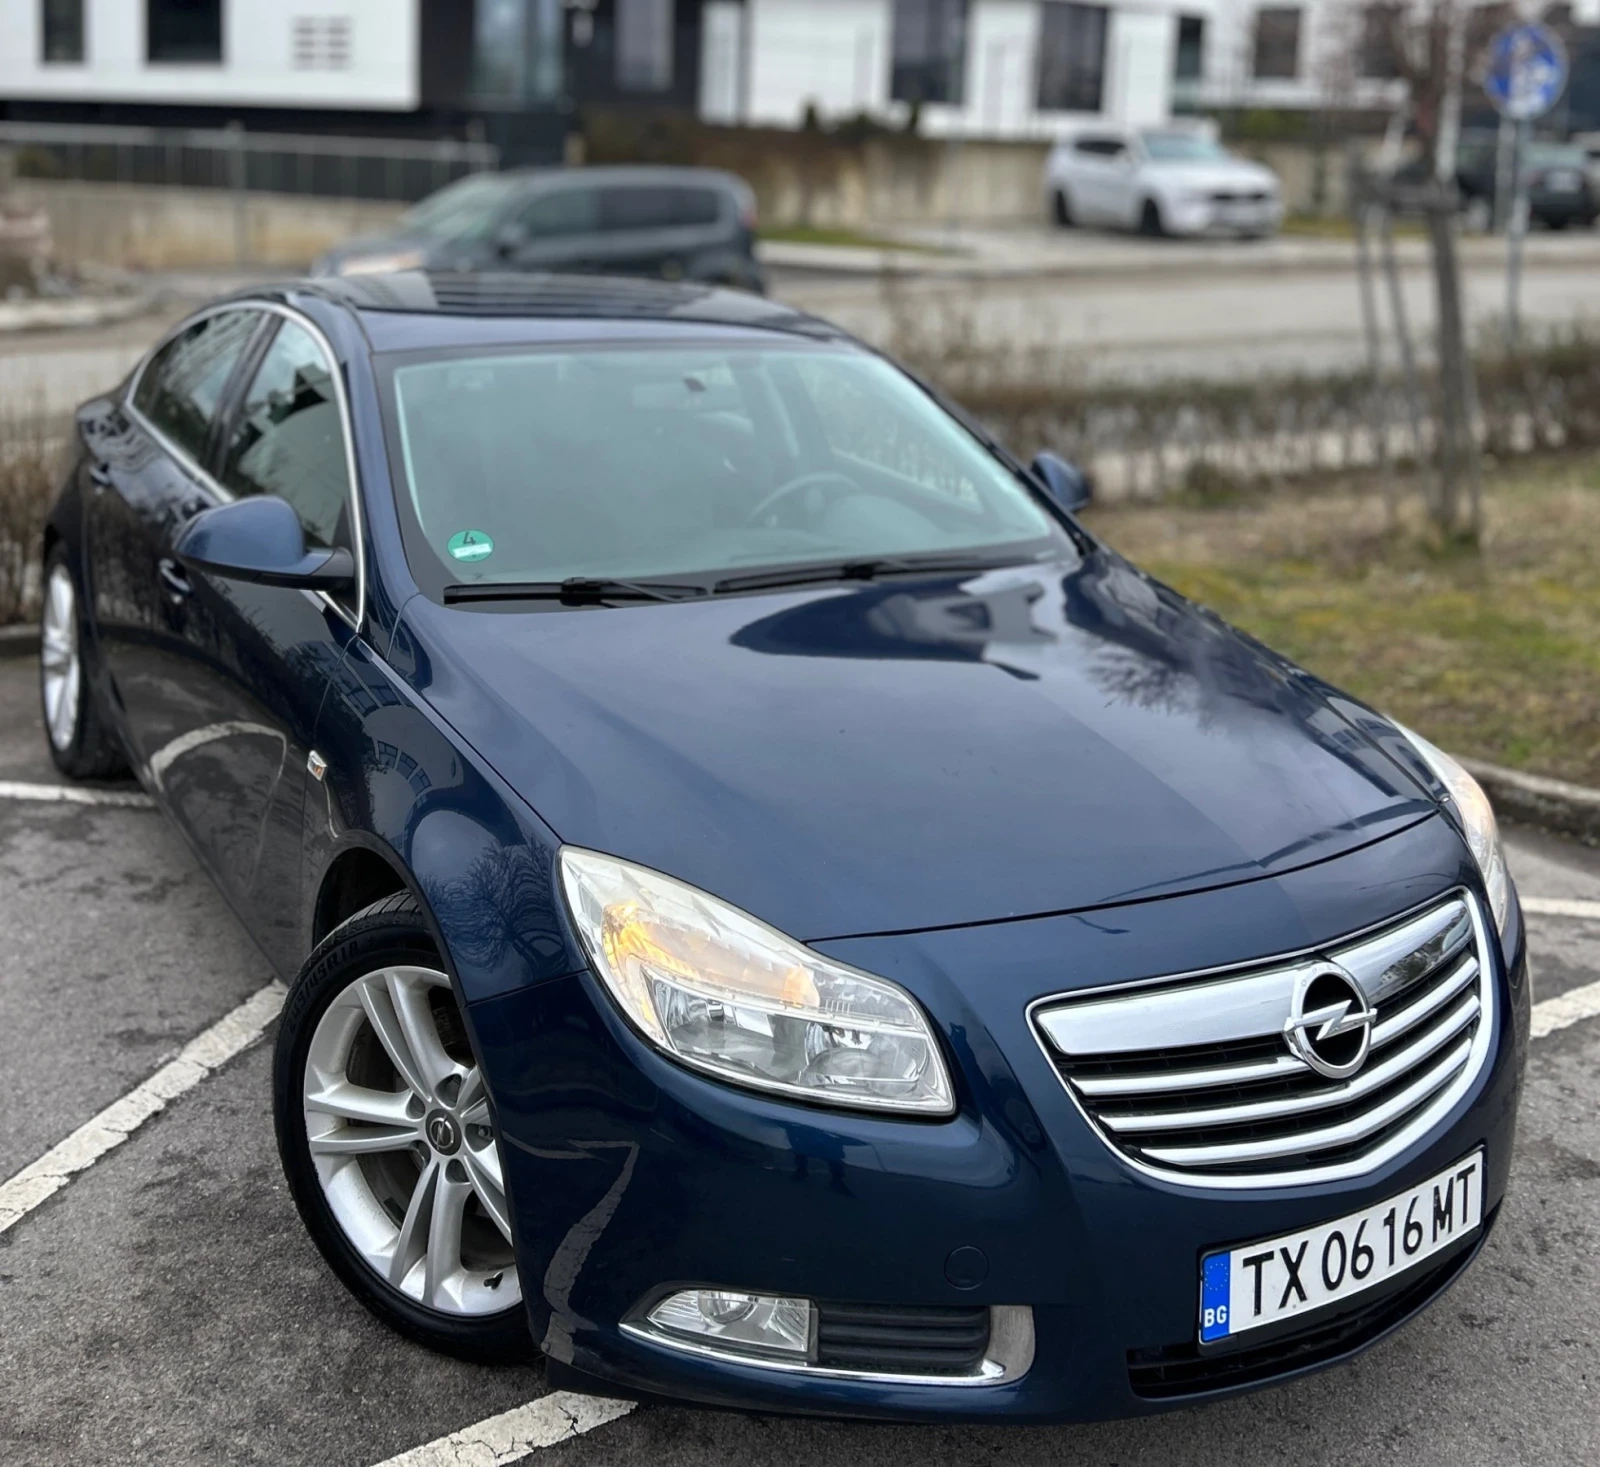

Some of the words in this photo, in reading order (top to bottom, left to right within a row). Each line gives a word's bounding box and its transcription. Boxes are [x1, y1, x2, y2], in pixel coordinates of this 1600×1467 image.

[462, 531, 477, 545] 4
[1242, 1240, 1309, 1317] TX
[1321, 1195, 1423, 1291] 0616
[1432, 1162, 1477, 1244] MT
[1203, 1305, 1228, 1328] BG
